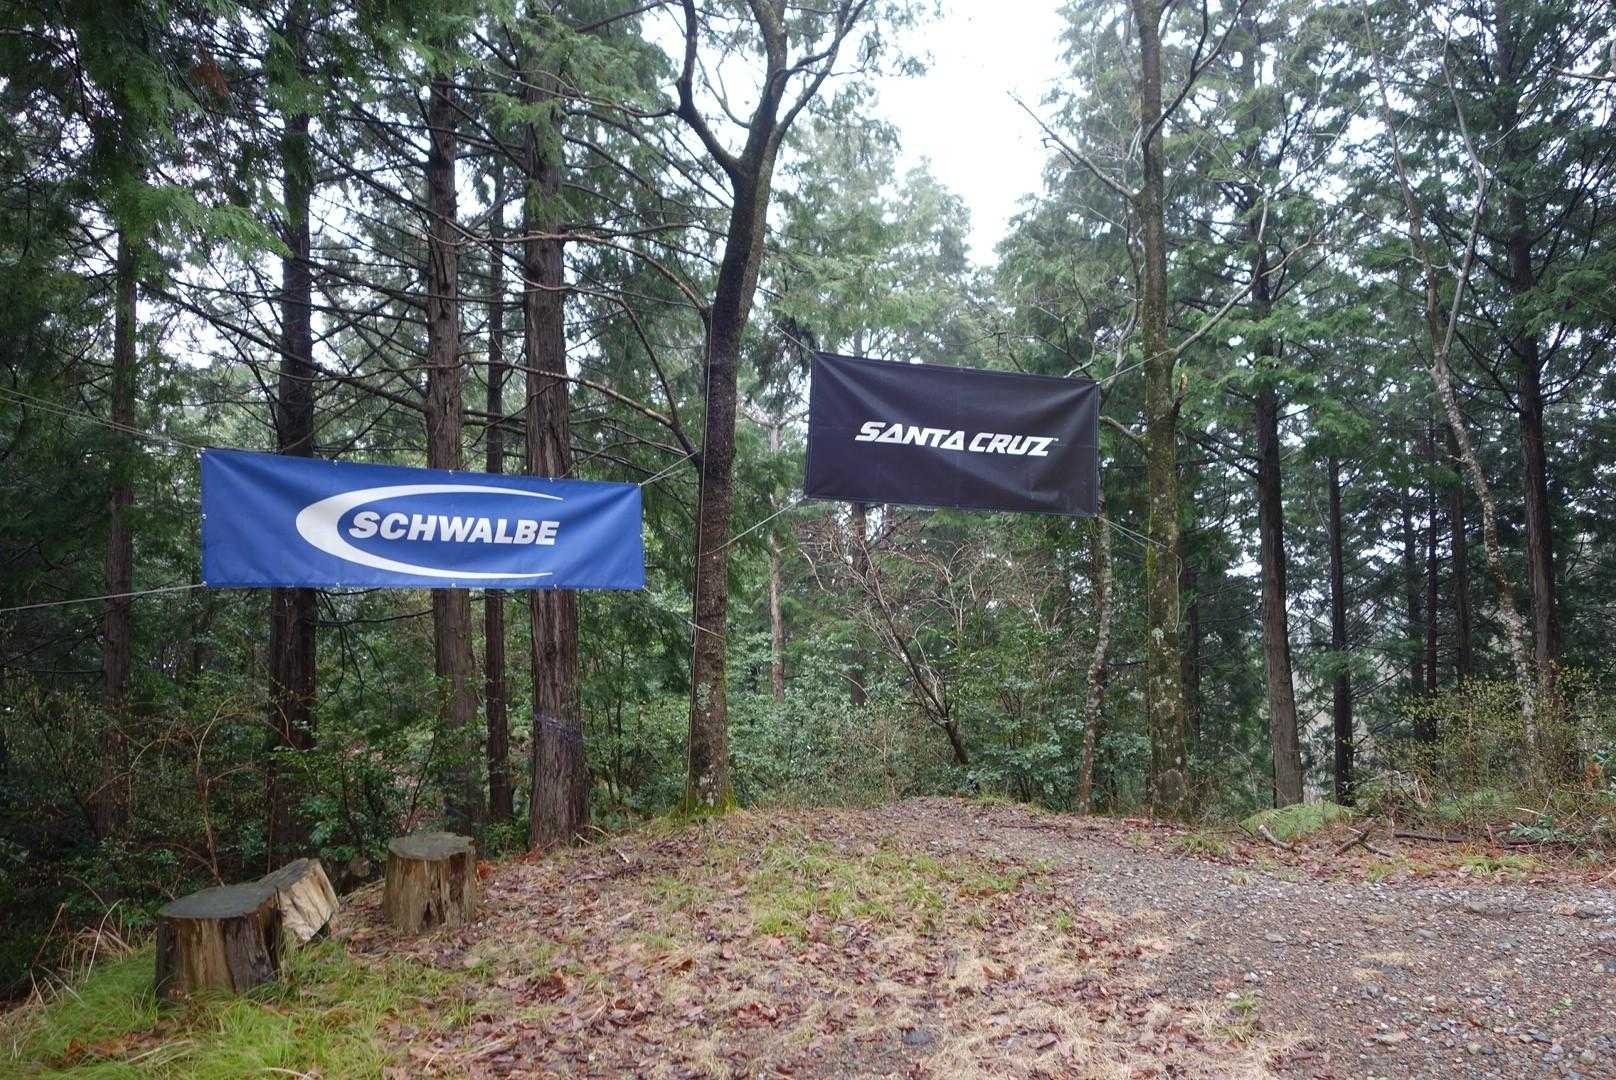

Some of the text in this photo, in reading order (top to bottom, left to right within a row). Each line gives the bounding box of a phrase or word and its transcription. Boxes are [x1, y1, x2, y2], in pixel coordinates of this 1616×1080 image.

[855, 421, 1054, 457] SANTA CRUZ
[348, 511, 560, 546] SCHWALBE
